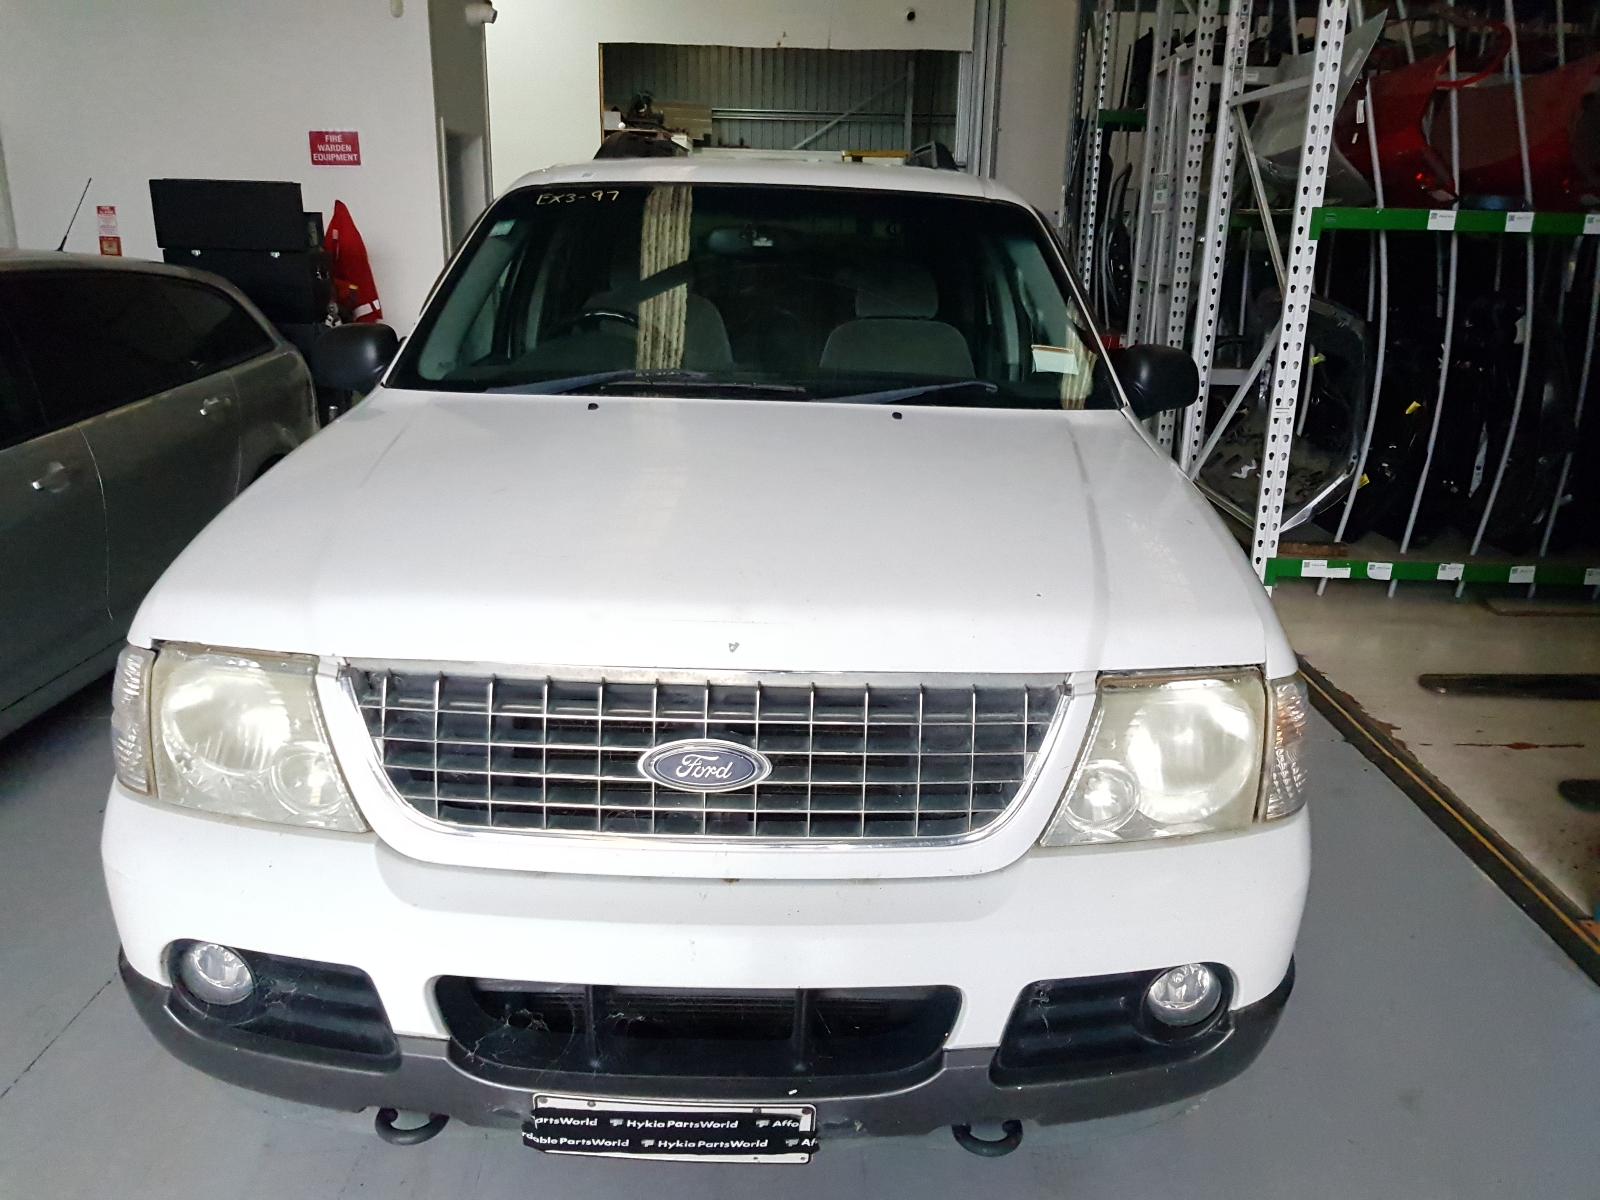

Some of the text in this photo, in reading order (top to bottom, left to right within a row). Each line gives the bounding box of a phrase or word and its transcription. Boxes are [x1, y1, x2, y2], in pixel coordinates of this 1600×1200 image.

[325, 134, 343, 143] FIRE
[317, 144, 352, 152] WARDEN
[312, 153, 358, 161] EQUIPMENT
[675, 753, 733, 779] Ford
